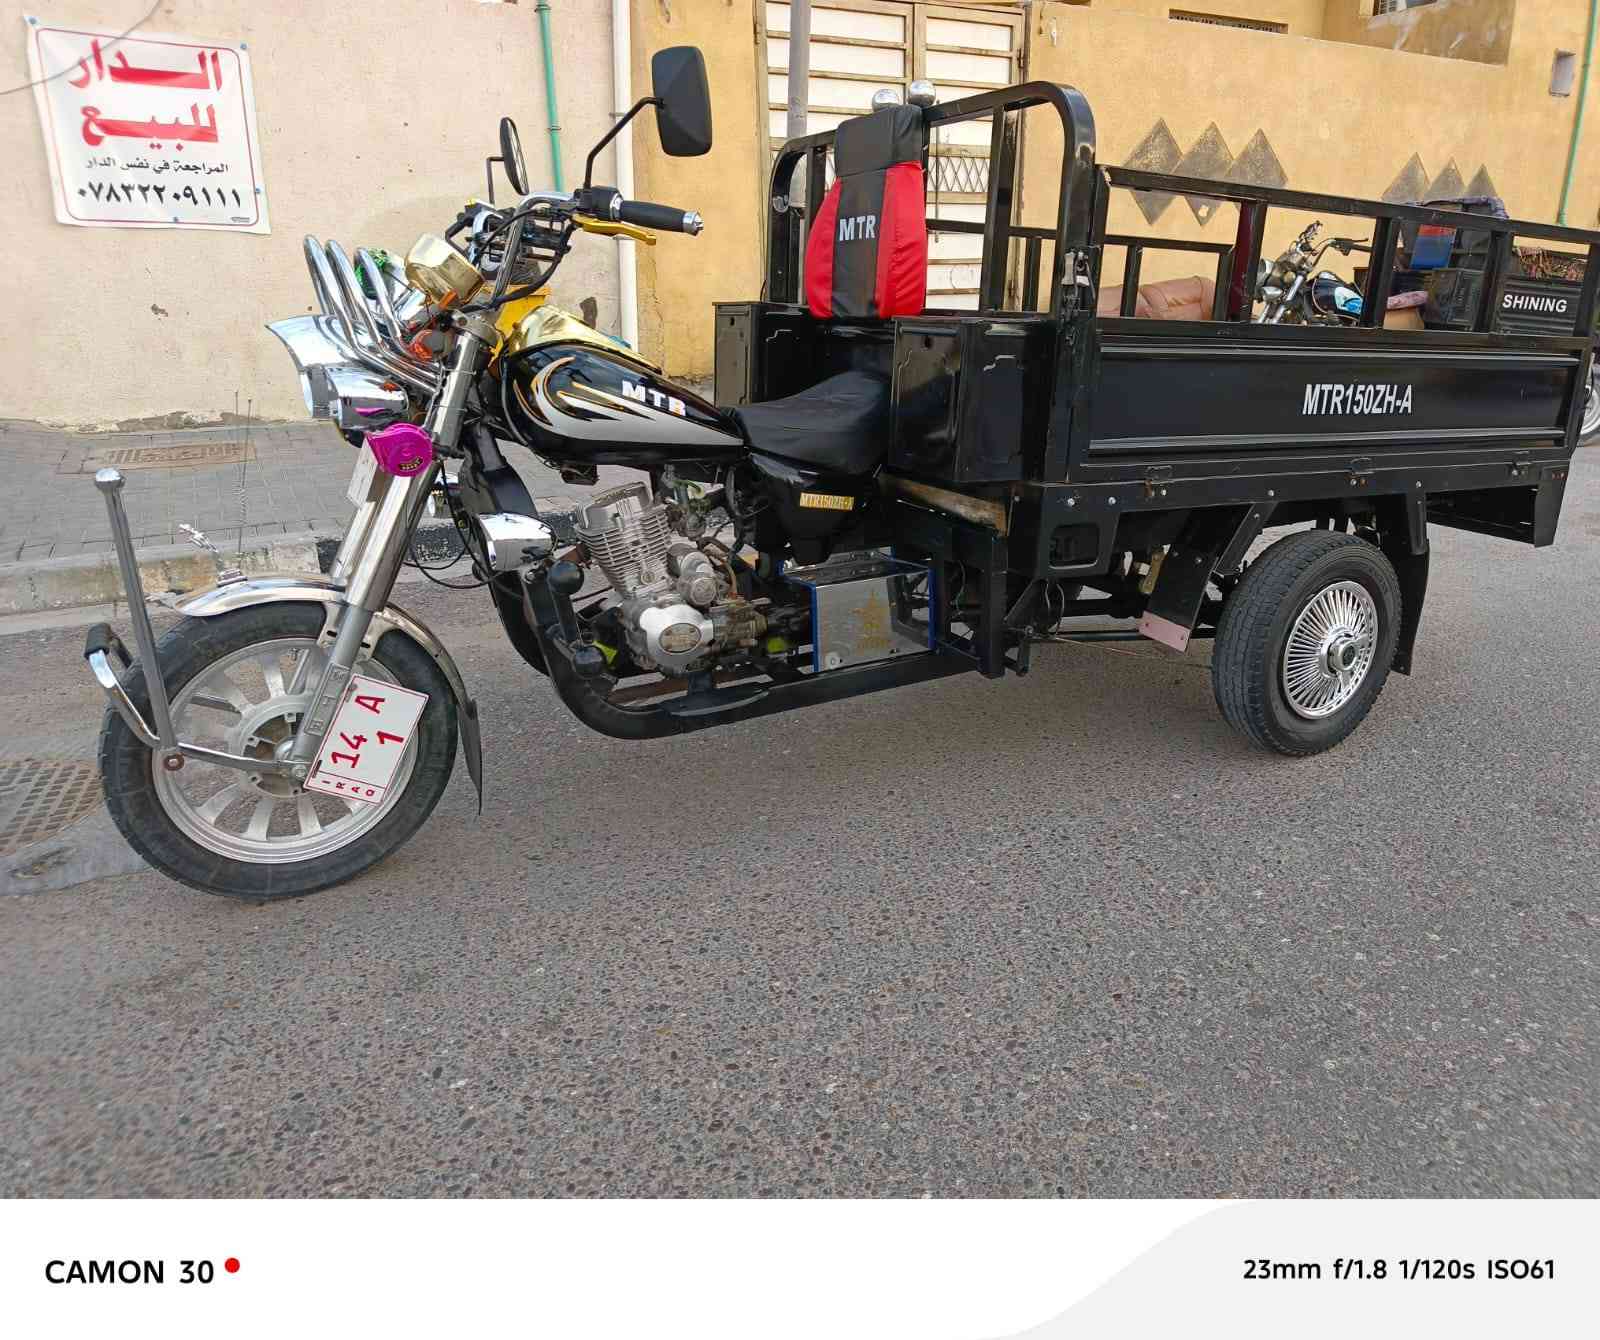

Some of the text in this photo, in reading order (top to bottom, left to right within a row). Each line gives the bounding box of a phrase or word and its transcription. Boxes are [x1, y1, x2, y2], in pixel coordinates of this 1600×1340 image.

[67, 39, 222, 91] الدار
[80, 103, 219, 152] للبيع
[85, 156, 229, 175] المراجعة في نفس الدار
[839, 215, 876, 241] MTR
[1503, 294, 1567, 313] SHINING
[622, 380, 687, 417] MTR
[1302, 384, 1413, 415] MTR150ZH-A
[331, 695, 385, 769] 14 A
[376, 731, 405, 745] 1
[322, 780, 375, 797] IRAQ
